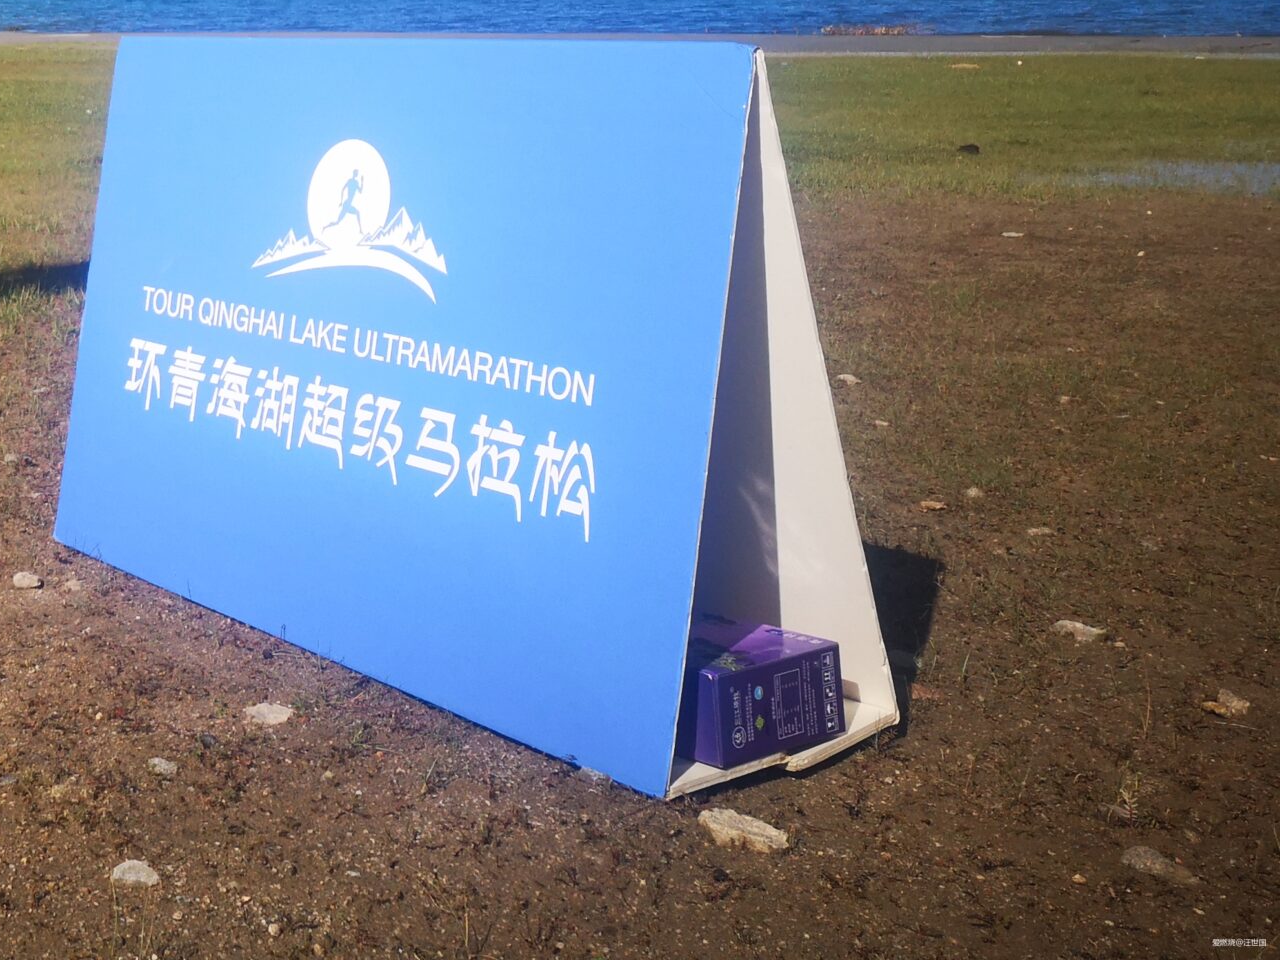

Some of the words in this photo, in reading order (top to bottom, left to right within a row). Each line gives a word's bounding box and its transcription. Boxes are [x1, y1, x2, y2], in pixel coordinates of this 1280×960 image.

[142, 285, 195, 321] TOUR
[198, 297, 285, 340] QINGHAI
[288, 314, 349, 354] LAKE
[352, 327, 595, 407] ULTRAMARATHON
[124, 337, 596, 543] 环青海湖超级马拉松
